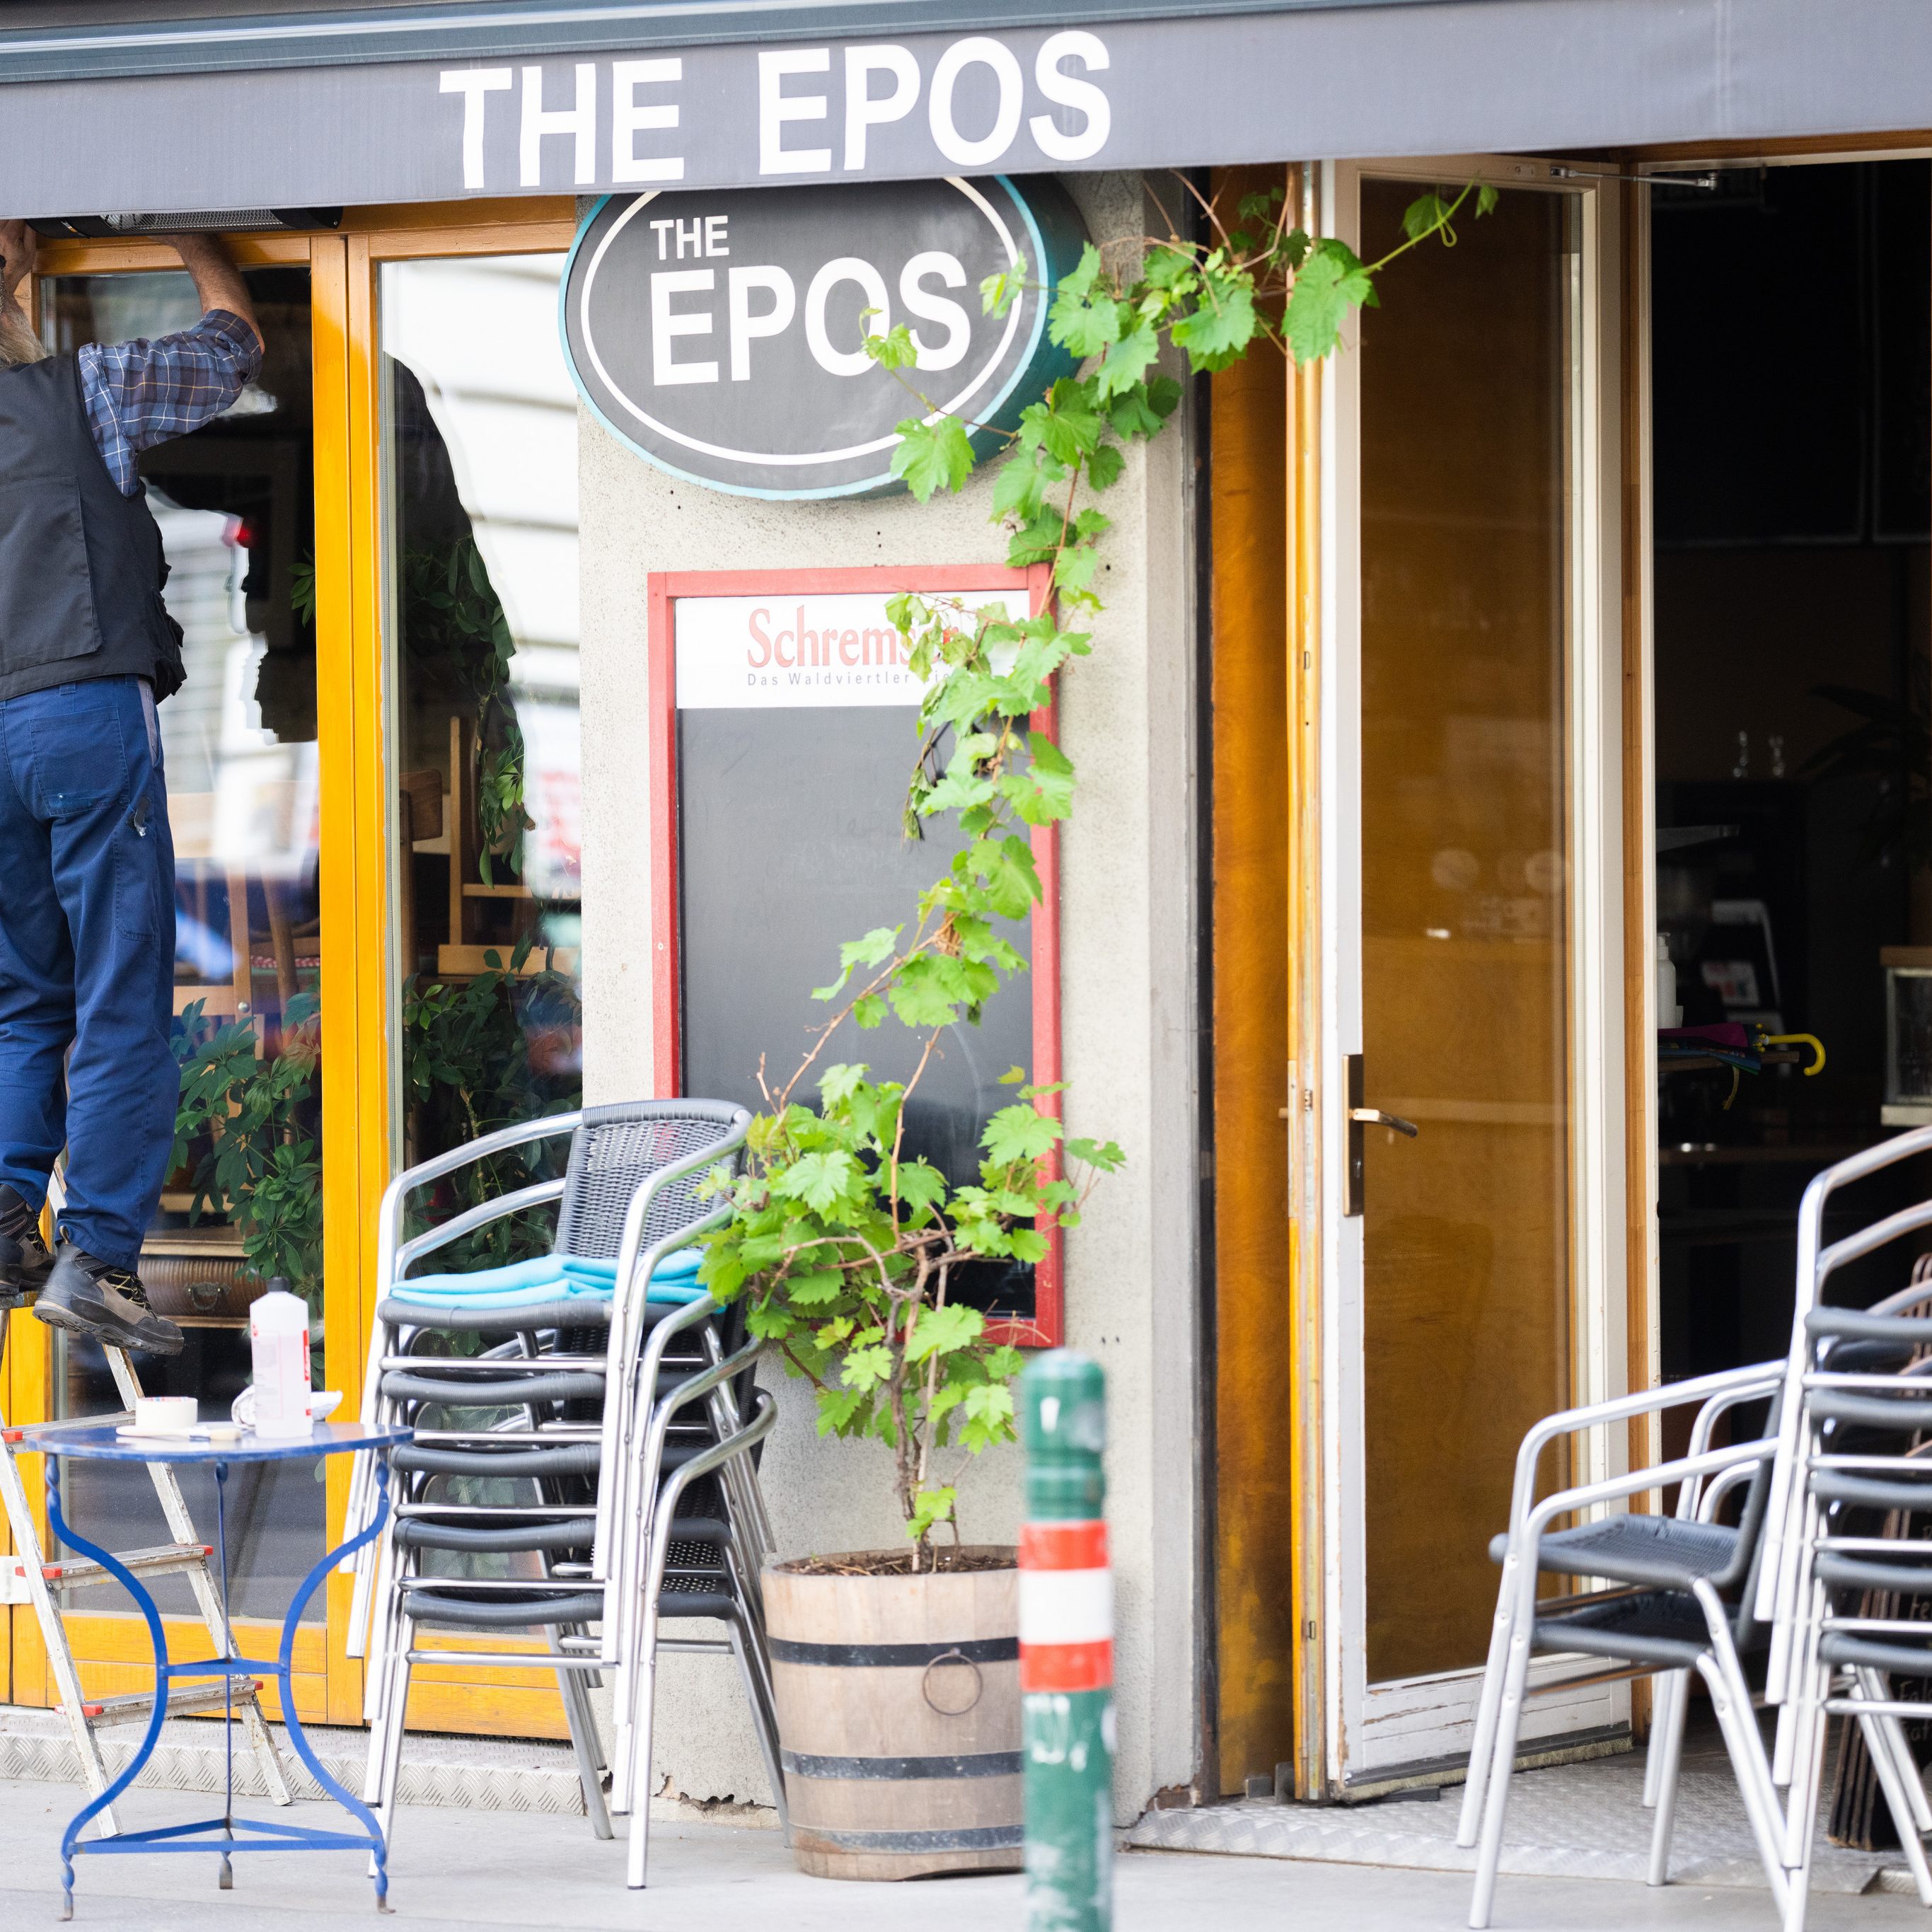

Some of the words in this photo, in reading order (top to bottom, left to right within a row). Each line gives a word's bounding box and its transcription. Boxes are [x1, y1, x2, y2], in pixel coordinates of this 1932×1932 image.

[439, 58, 684, 190] THE
[758, 30, 1111, 175] EPOS
[649, 215, 729, 260] THE
[651, 250, 971, 386] EPOS
[748, 673, 778, 686] Das
[788, 671, 910, 686] Waldviertler
